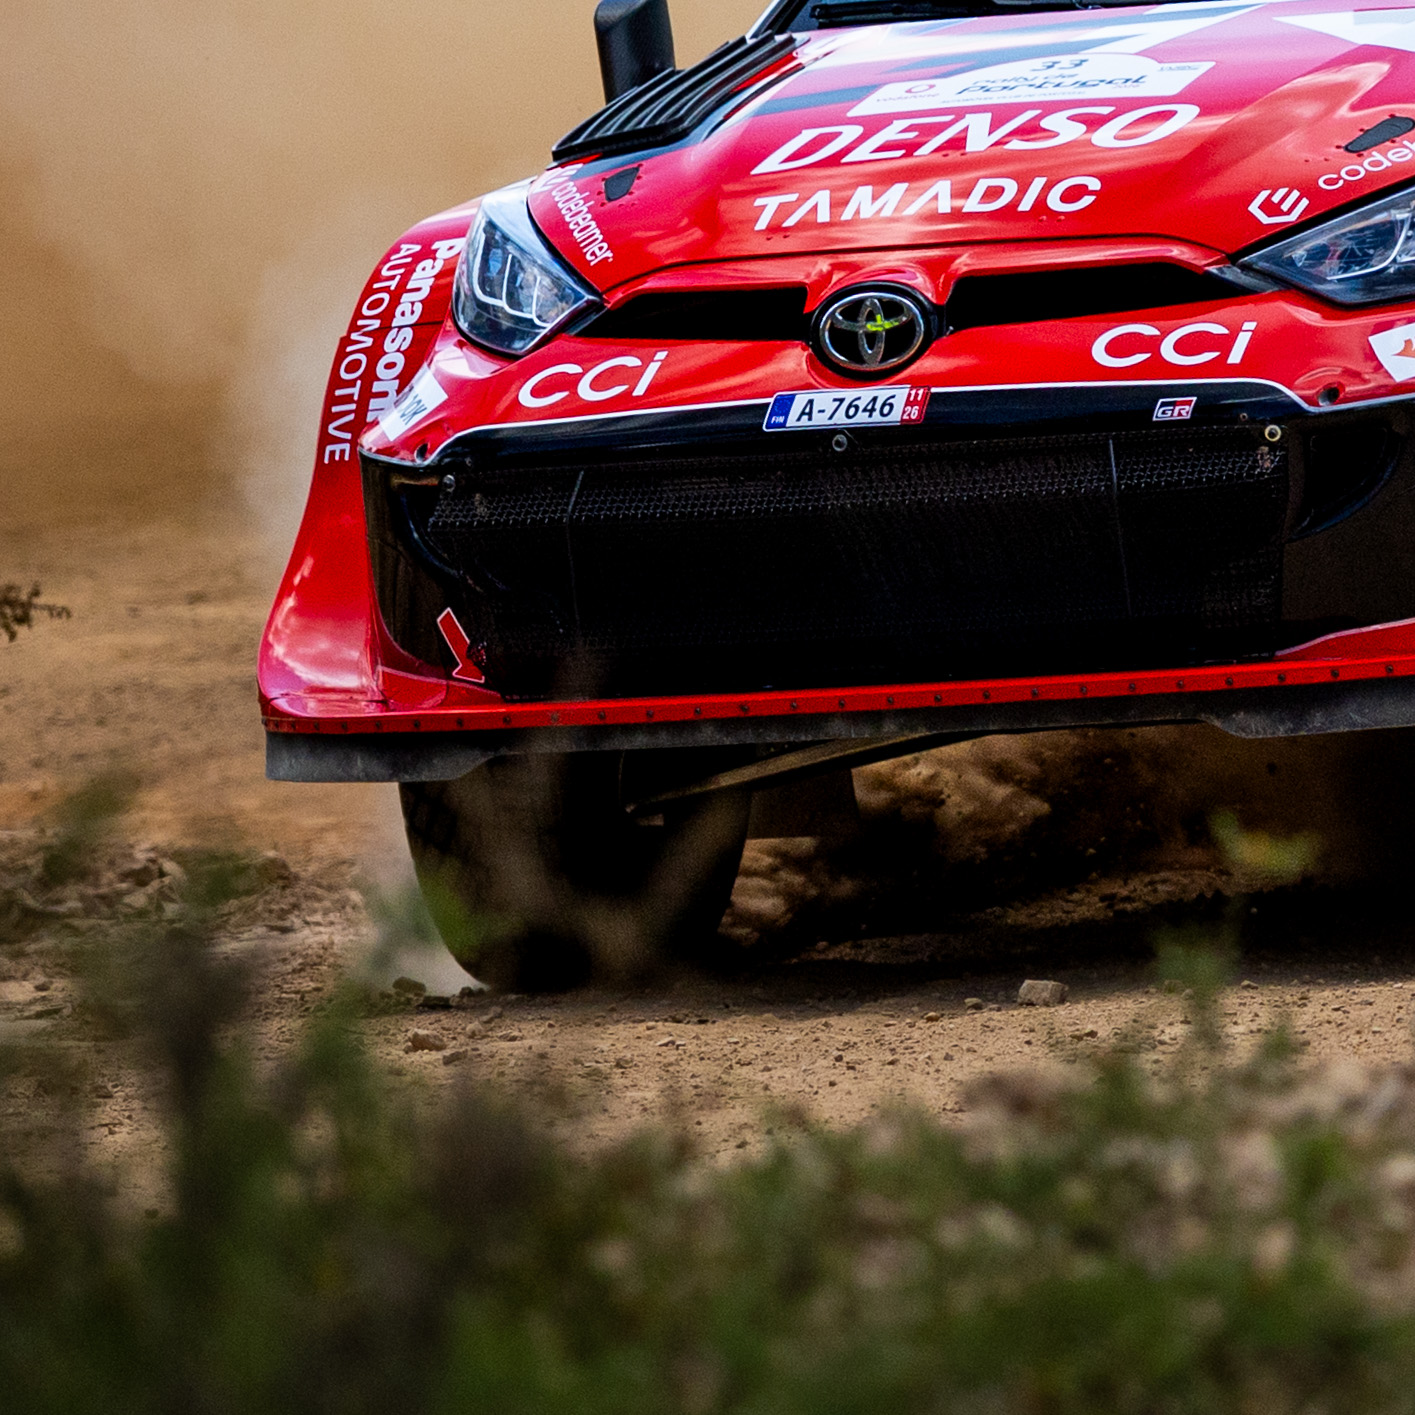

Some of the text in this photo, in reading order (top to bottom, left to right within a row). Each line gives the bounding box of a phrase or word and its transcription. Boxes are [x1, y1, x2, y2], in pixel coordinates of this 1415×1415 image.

[956, 74, 1149, 95] Portugal
[750, 104, 1200, 175] DENSO
[551, 181, 613, 266] codebeamer
[751, 176, 1101, 231] TAMADIC
[324, 243, 421, 464] AUTOMOTIVE
[796, 394, 897, 422] A-7646
[909, 388, 924, 402] 11
[902, 406, 919, 420] 26
